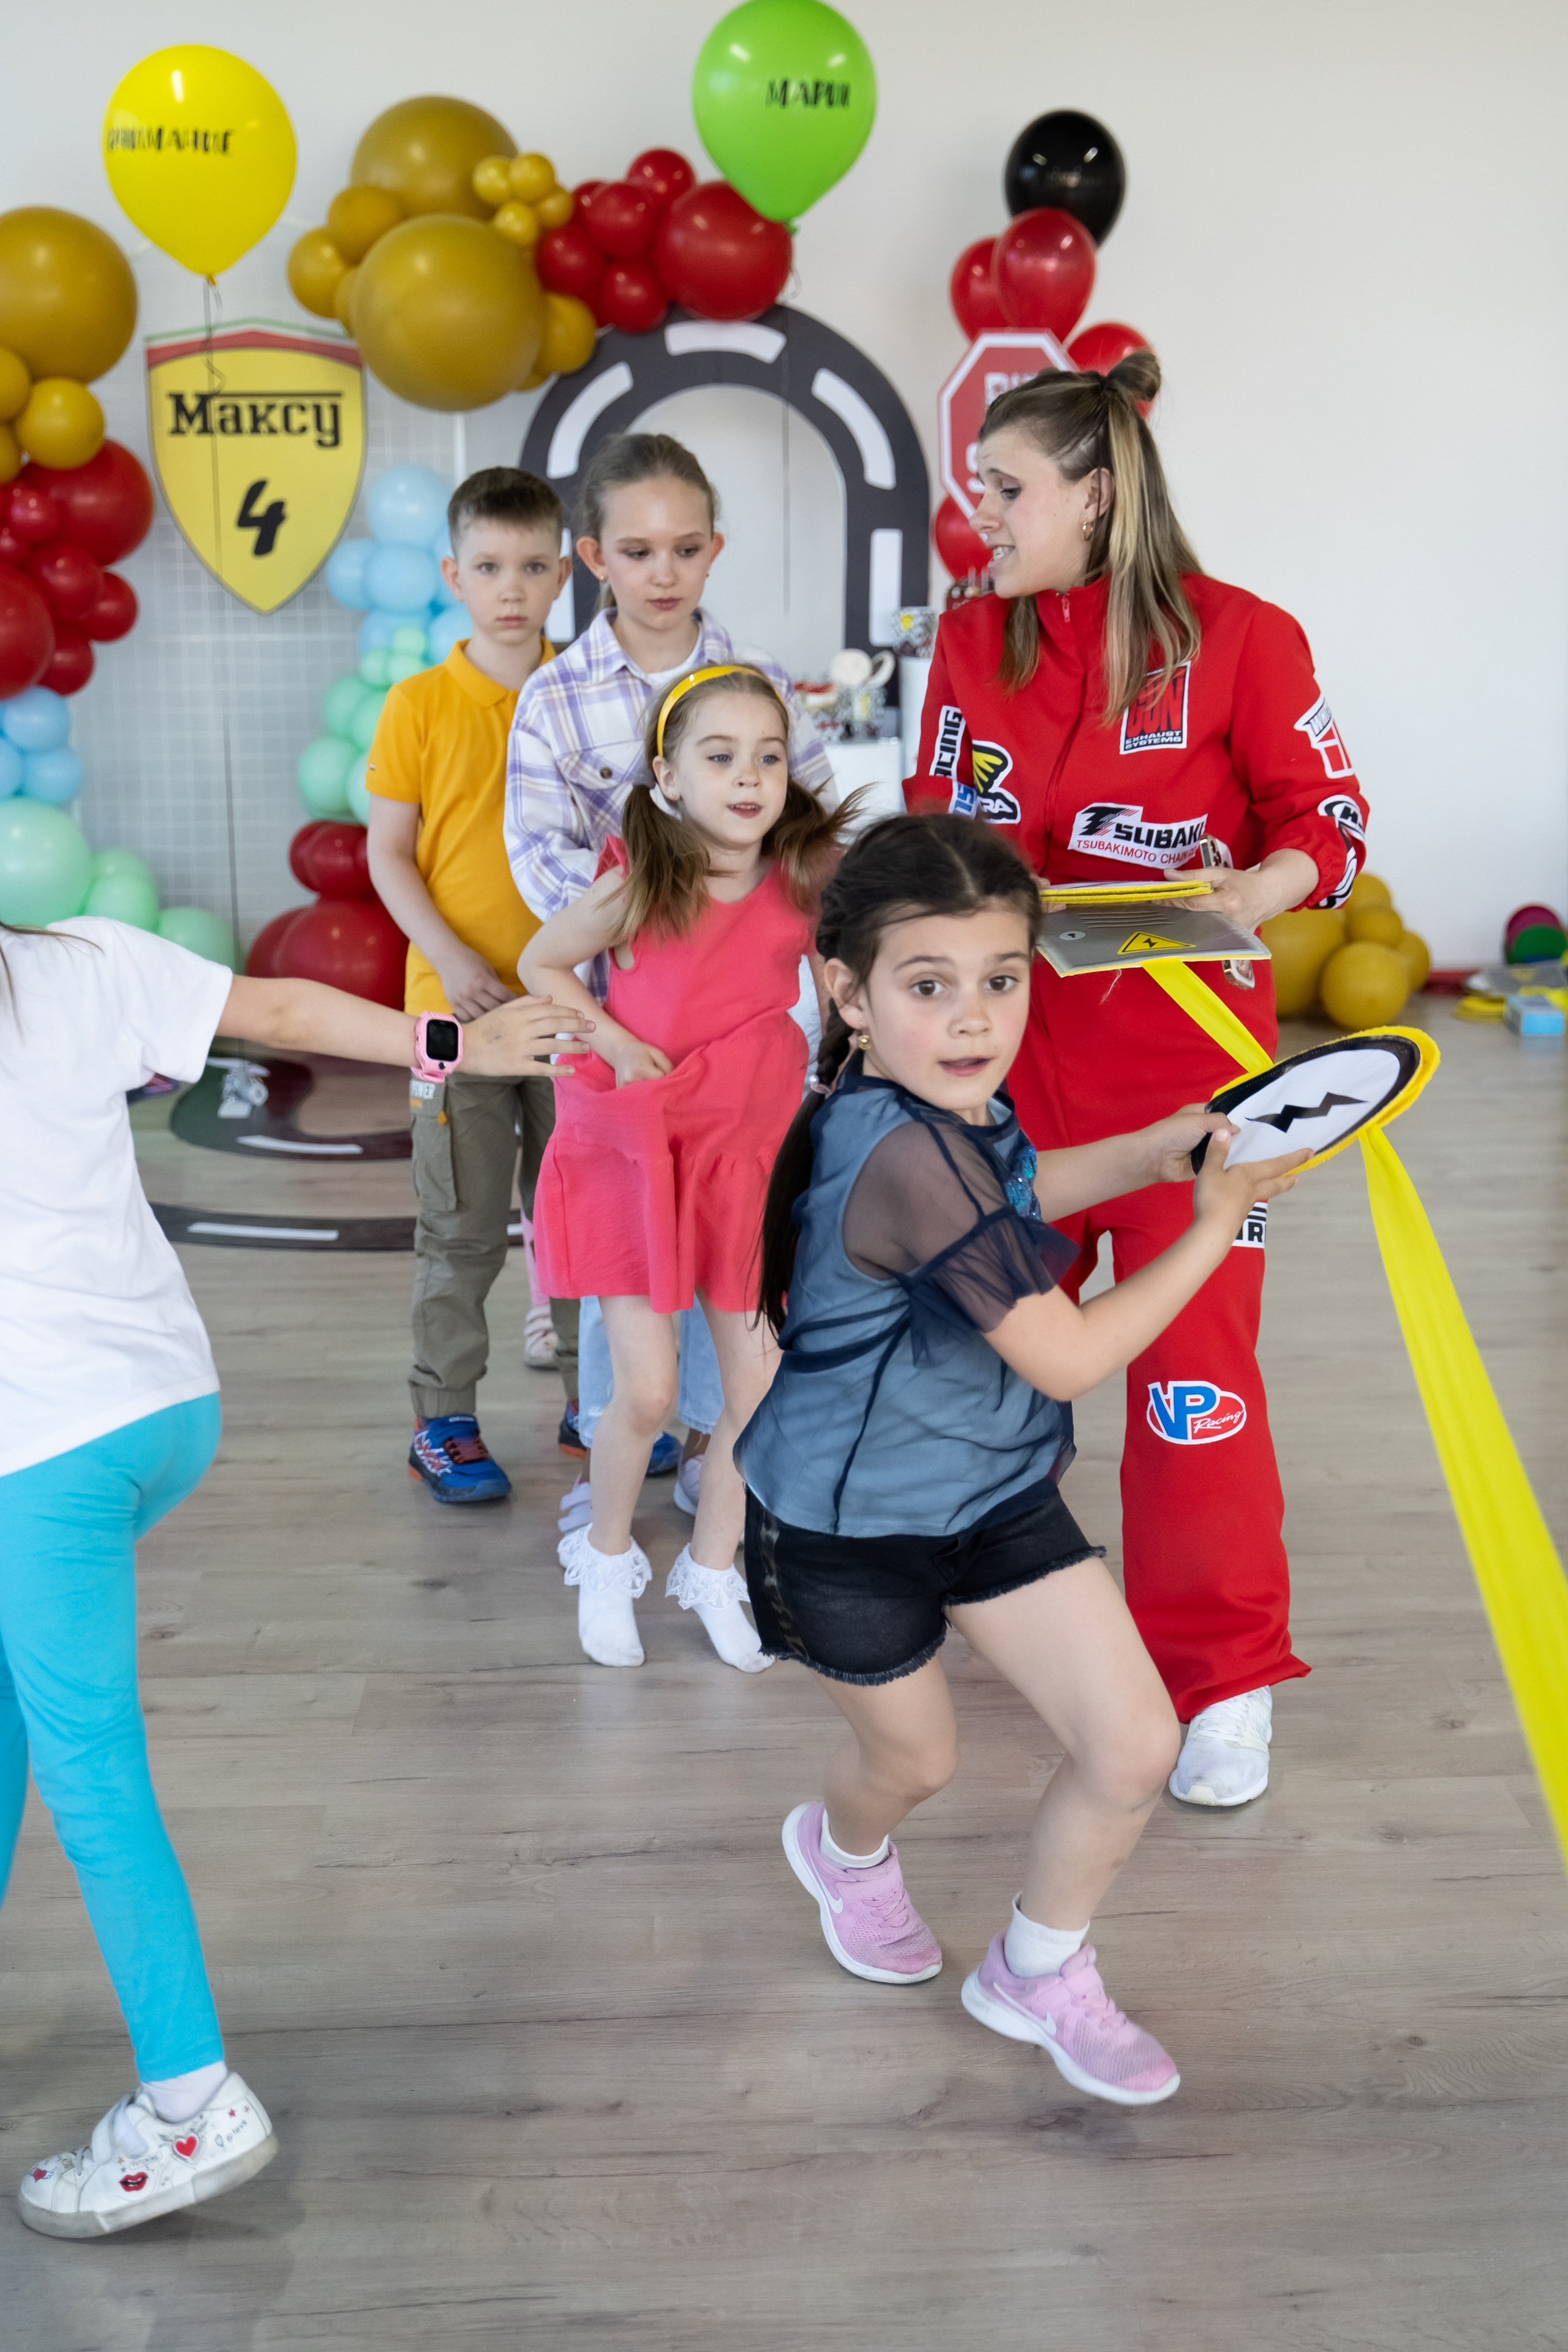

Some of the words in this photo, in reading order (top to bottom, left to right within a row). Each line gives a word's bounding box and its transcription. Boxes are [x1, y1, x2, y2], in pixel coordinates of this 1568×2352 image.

[167, 392, 342, 448] Максу
[237, 480, 287, 557] 4
[1077, 839, 1158, 862] TSUBAKIMOTO
[1152, 1385, 1216, 1440] VP
[1193, 1410, 1244, 1434] Racing
